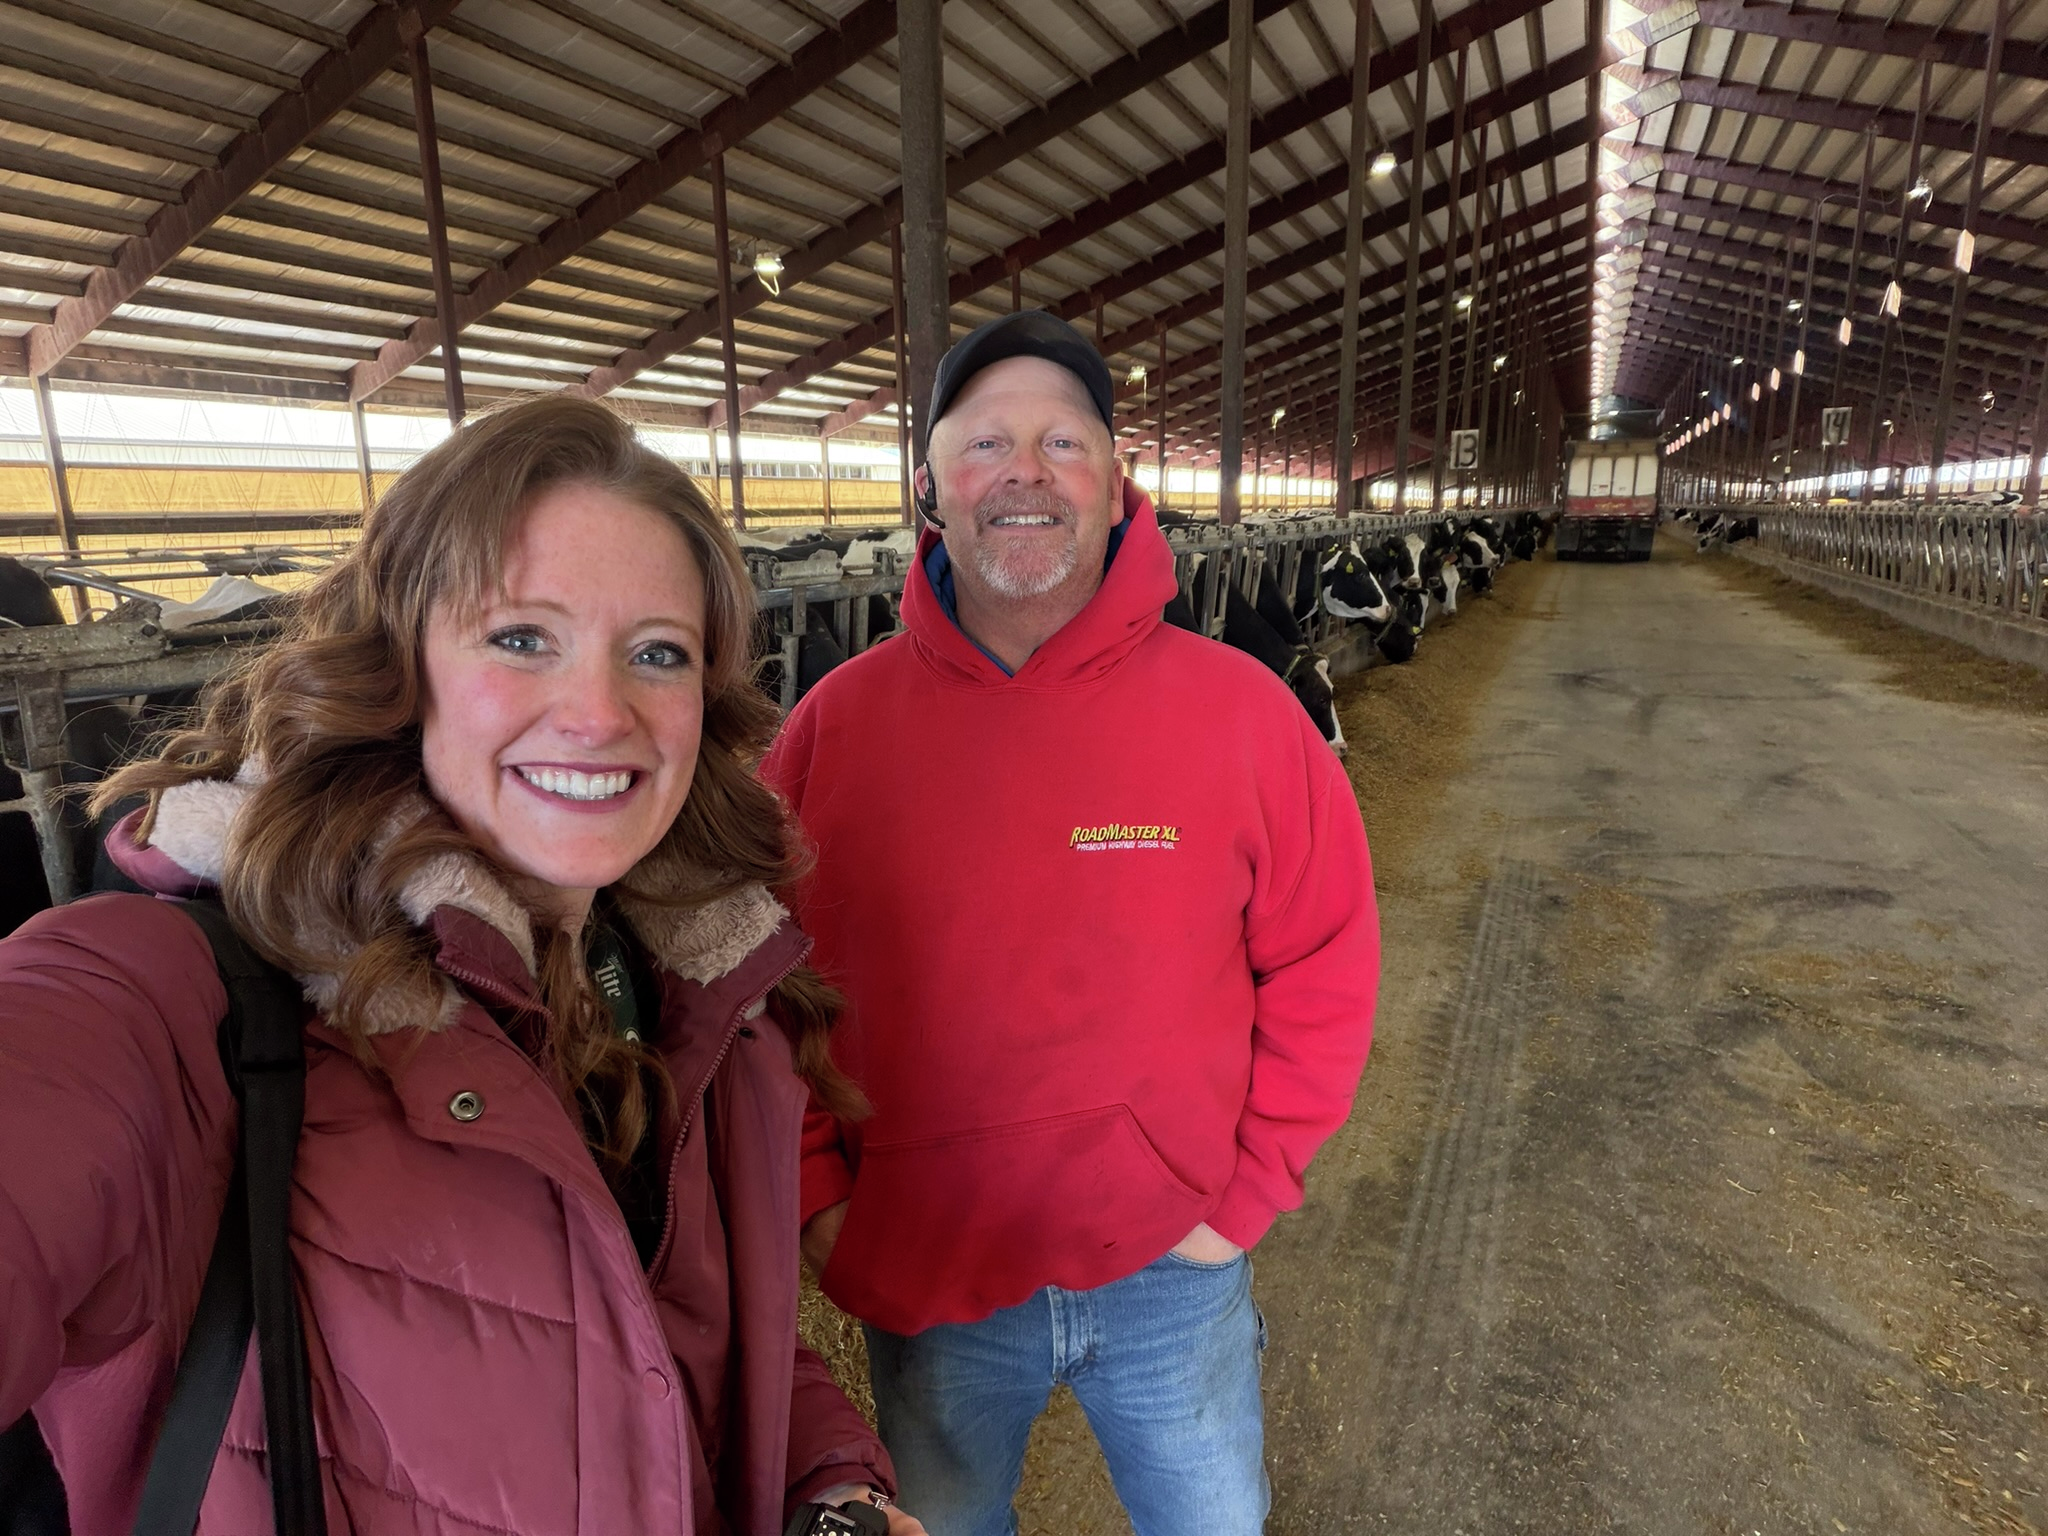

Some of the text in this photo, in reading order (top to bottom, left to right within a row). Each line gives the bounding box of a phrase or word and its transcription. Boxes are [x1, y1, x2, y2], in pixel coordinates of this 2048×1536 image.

[1826, 411, 1847, 443] 14
[1454, 433, 1477, 467] 13
[1077, 840, 1175, 851] PREMIUM HIGHWAY DIESEL FUEL
[1161, 825, 1180, 841] XL
[595, 963, 621, 997] Lite
